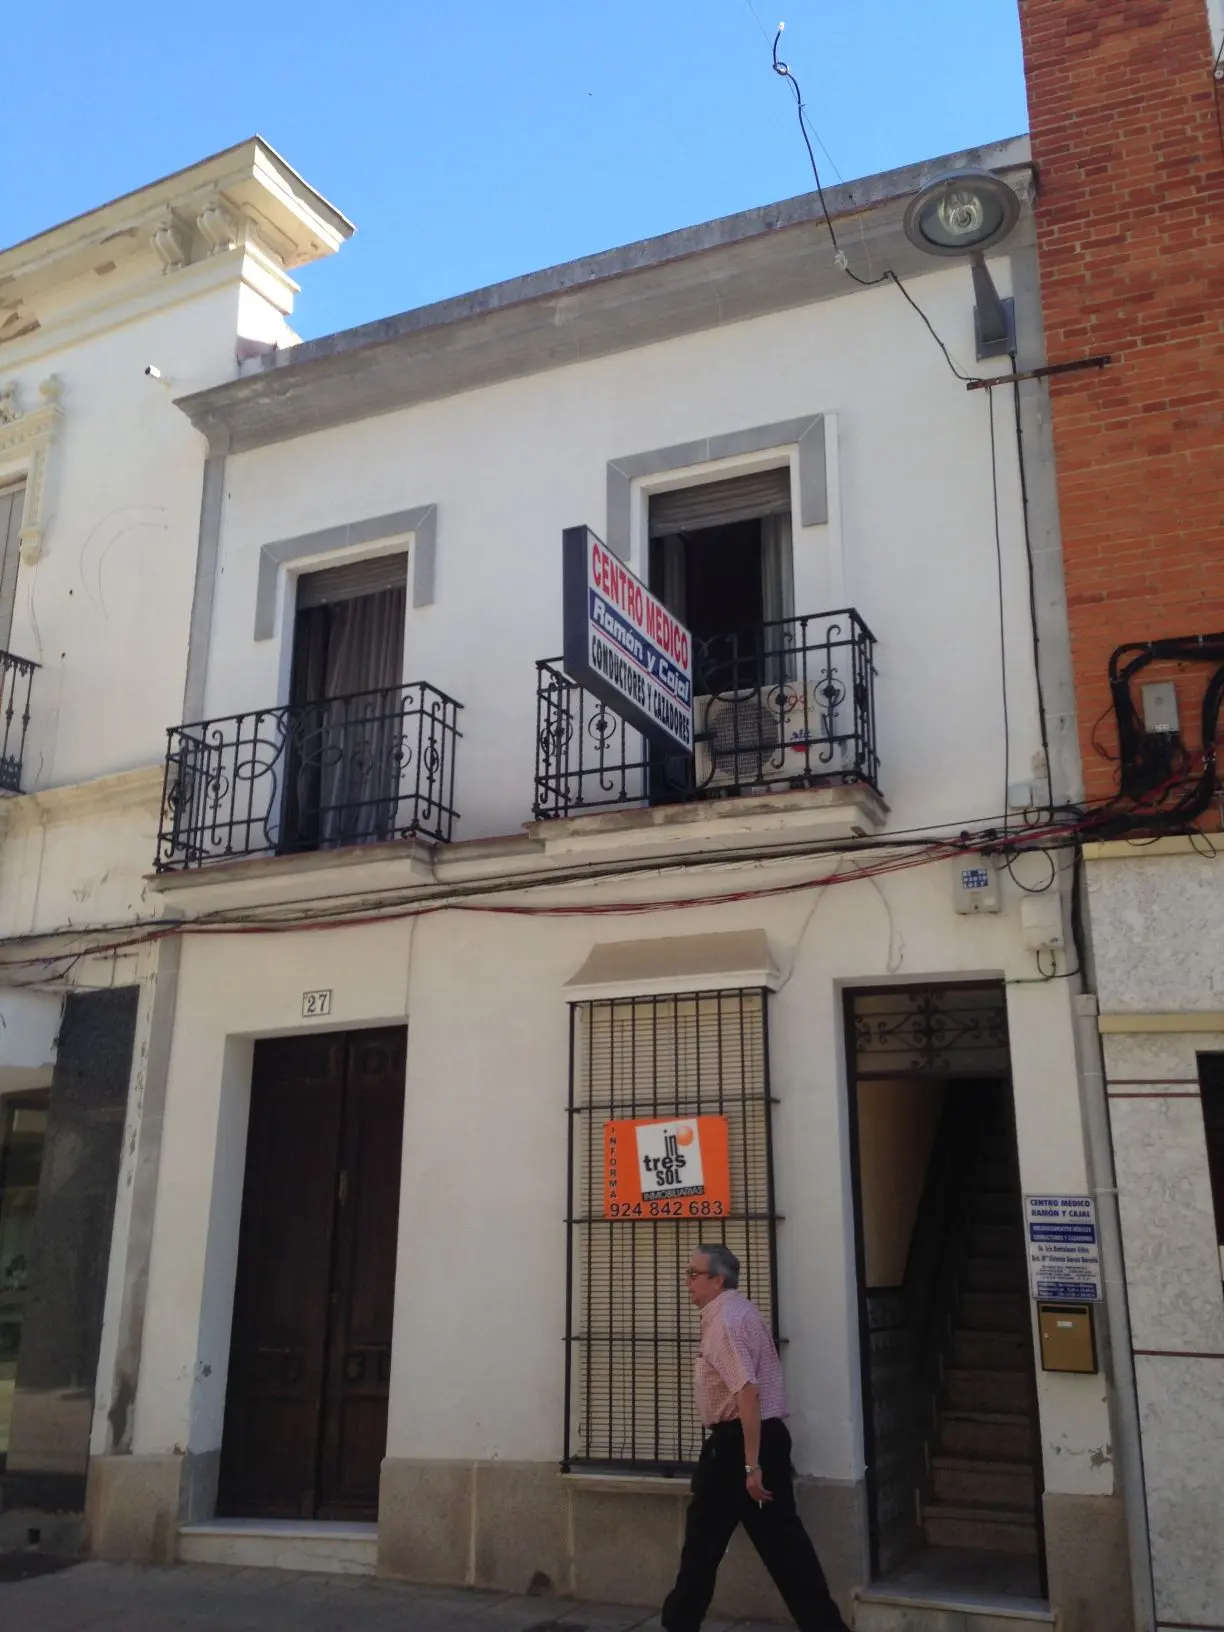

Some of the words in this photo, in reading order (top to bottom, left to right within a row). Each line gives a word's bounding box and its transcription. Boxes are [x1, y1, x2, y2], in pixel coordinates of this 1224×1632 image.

[591, 543, 643, 627] CENTRO
[646, 595, 688, 670] MEDICO
[593, 597, 643, 660] Ramón
[646, 650, 656, 674] y
[659, 658, 690, 702] Cajal
[592, 635, 645, 707] CONDUCTORES
[647, 682, 652, 712] Y
[654, 688, 690, 745] CAZADORES
[307, 994, 327, 1012] 27
[663, 1129, 678, 1157] in
[609, 1126, 617, 1199] INFORMA
[643, 1154, 686, 1171] tres
[610, 1202, 642, 1216] 924
[649, 1201, 682, 1216] 842
[689, 1200, 723, 1215] 683
[1069, 1210, 1091, 1218] CAJAL
